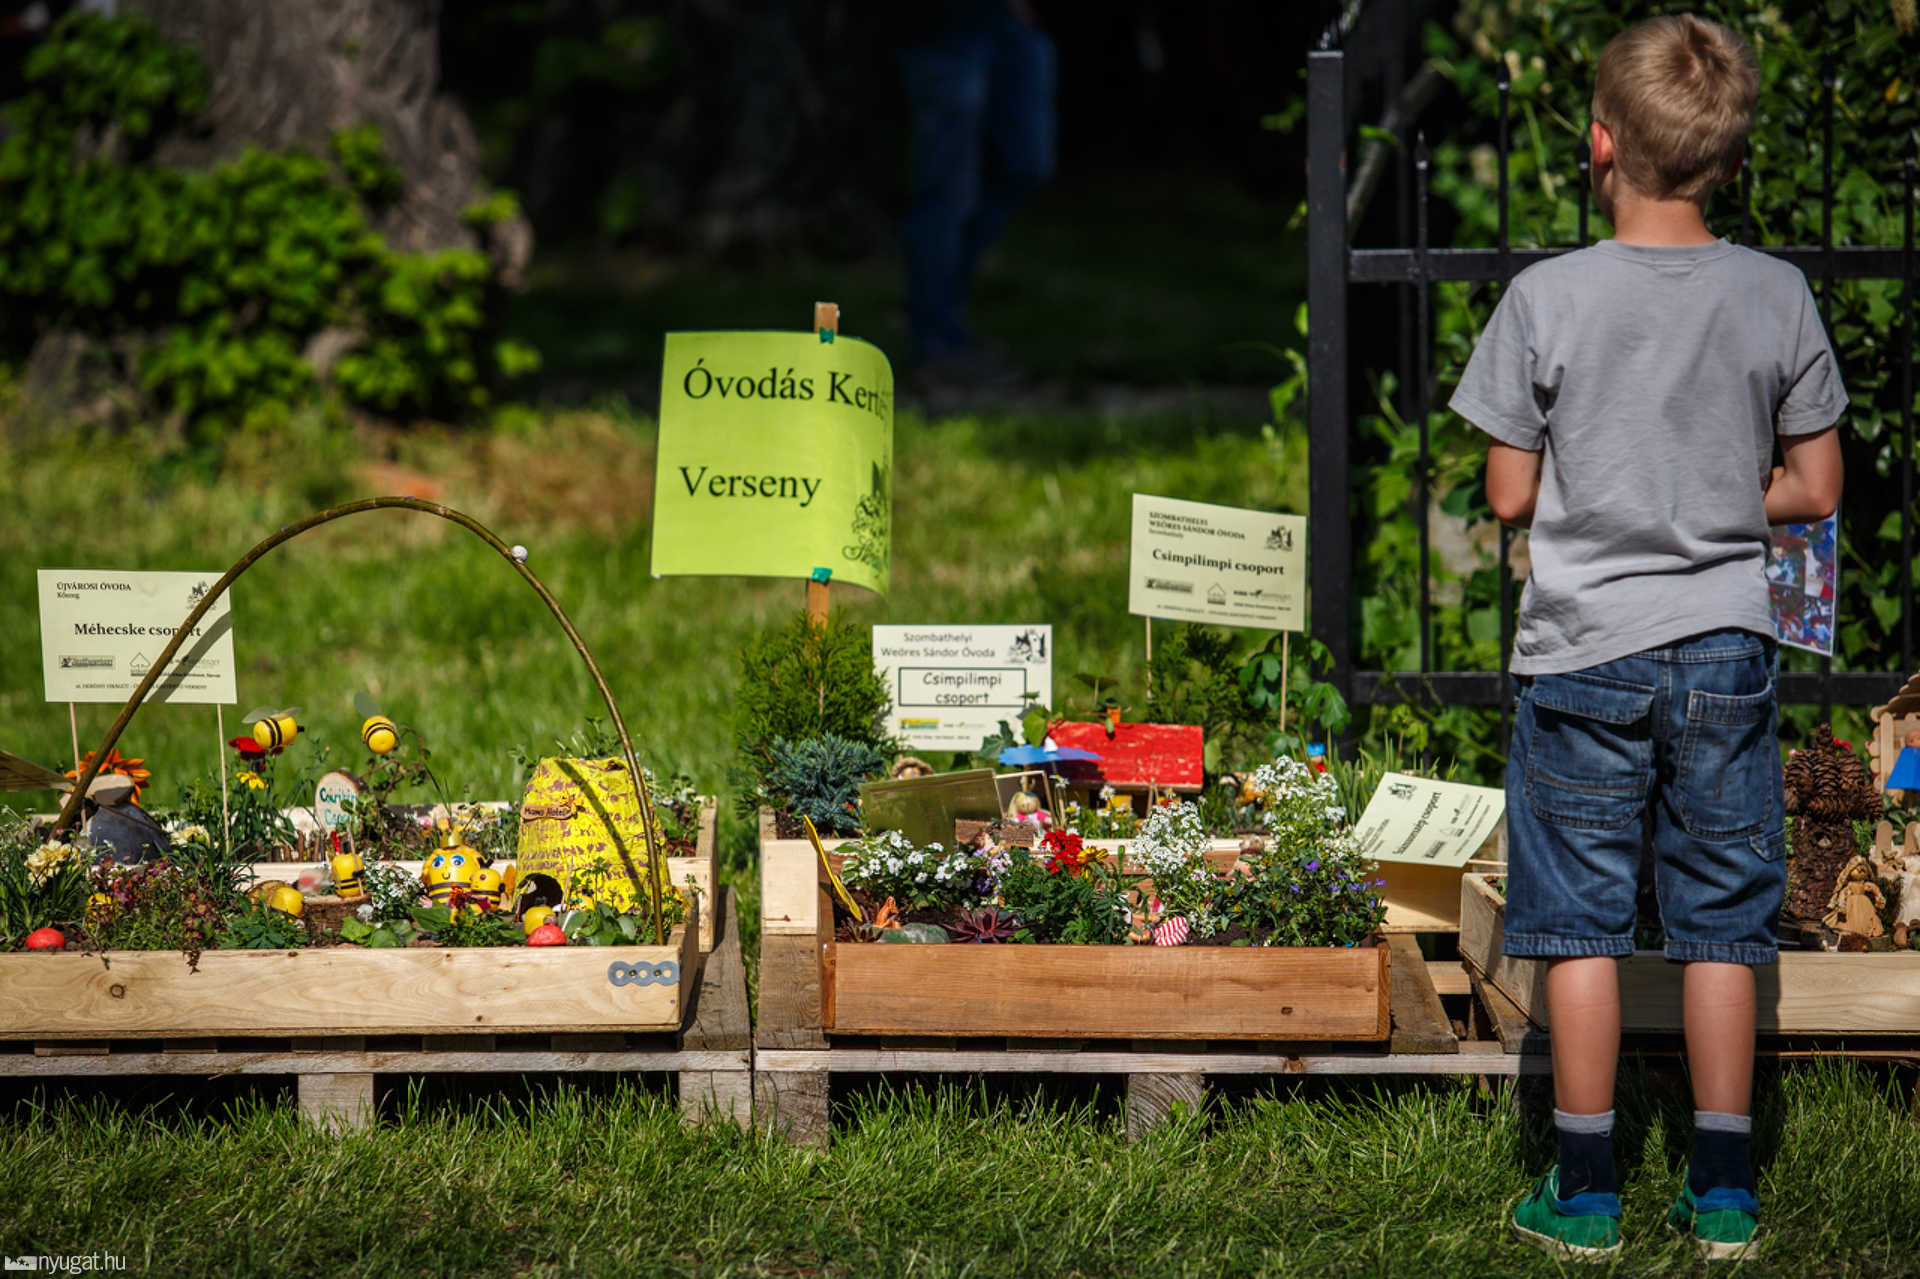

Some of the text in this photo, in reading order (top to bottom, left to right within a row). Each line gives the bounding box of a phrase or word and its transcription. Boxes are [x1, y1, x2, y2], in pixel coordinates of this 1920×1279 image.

[683, 358, 814, 400] Óvodás
[679, 466, 822, 507] Verseny
[1152, 548, 1285, 576] Csimpilimpi csoport
[100, 582, 131, 591] ÓVODA
[74, 623, 146, 636] Méhecske
[904, 632, 973, 645] Szombathelyi
[923, 647, 959, 658] Sándor
[922, 672, 1002, 689] Csimpilimpi
[935, 692, 990, 706] csoport
[1421, 791, 1442, 822] csoport
